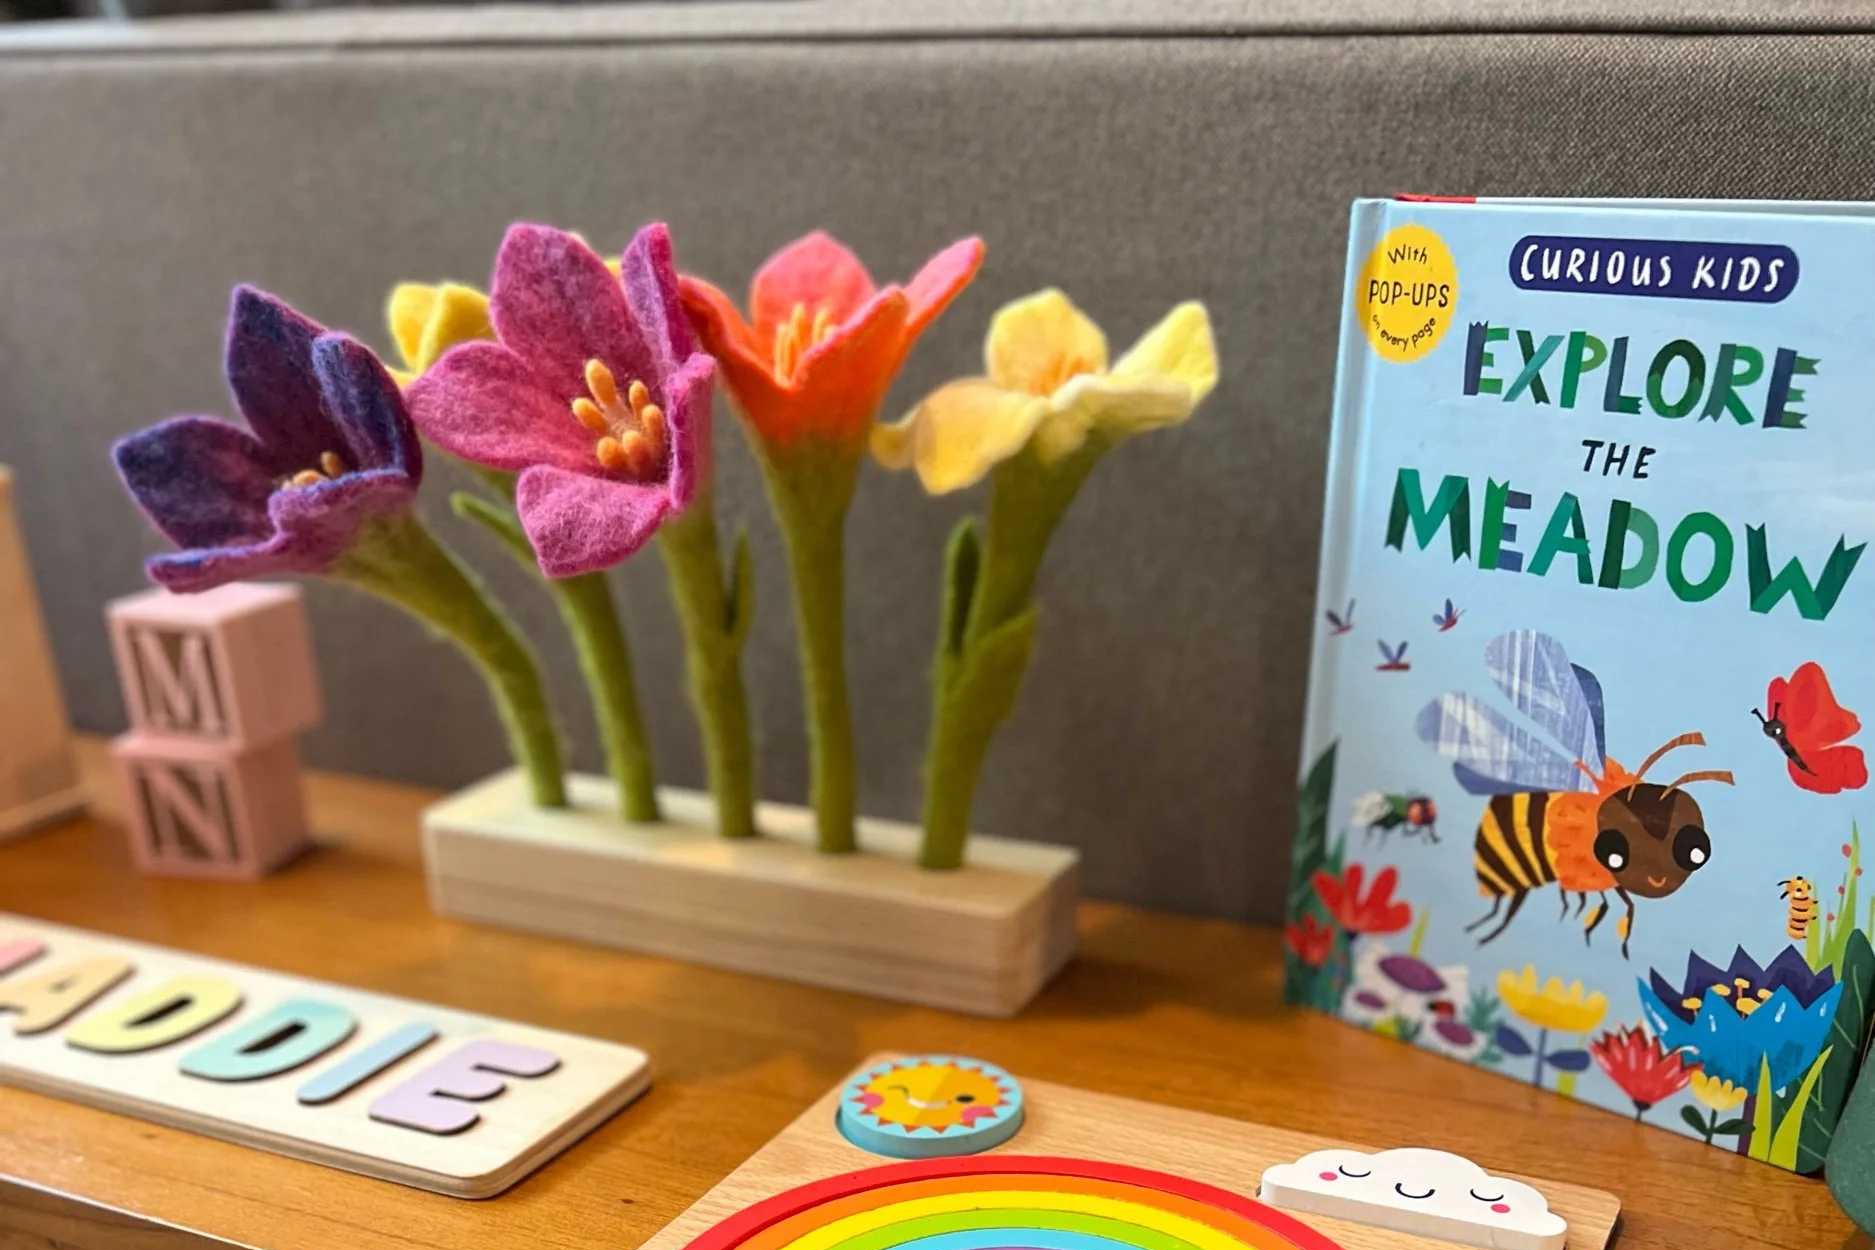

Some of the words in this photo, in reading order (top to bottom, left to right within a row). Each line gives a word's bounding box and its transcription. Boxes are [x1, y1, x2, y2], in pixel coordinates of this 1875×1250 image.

[1387, 244, 1428, 264] With
[1519, 243, 1673, 287] CURIOUS
[1691, 254, 1786, 293] KIDS
[1368, 279, 1450, 308] POP-UPS
[1380, 329, 1410, 353] every
[1411, 317, 1437, 349] page
[1463, 320, 1822, 429] EXPLORE
[1581, 439, 1657, 480] THE
[1384, 467, 1869, 621] MEADOW
[124, 622, 230, 738] M
[131, 760, 243, 865] N
[0, 937, 563, 1136] ADDIE
